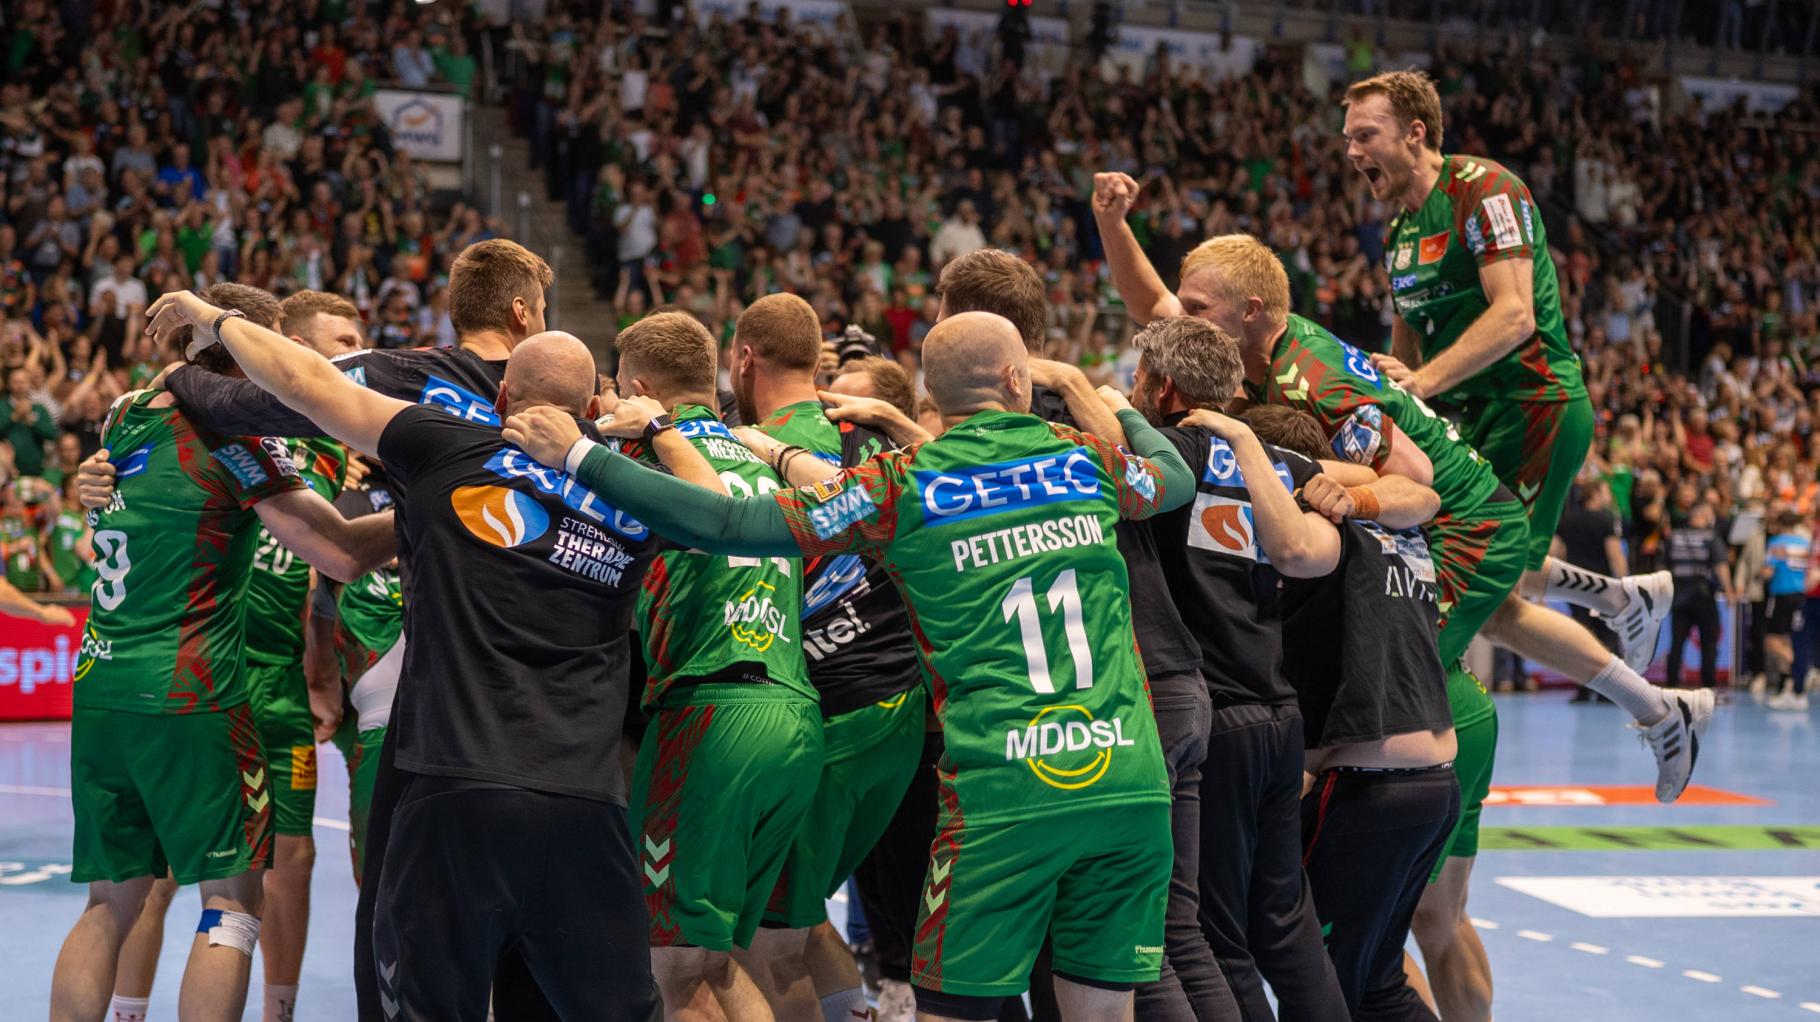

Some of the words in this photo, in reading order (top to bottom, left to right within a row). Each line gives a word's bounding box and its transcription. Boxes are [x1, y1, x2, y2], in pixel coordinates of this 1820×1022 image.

[220, 443, 265, 486] SWM
[925, 453, 1100, 517] GETEC
[812, 484, 872, 529] SWM
[549, 545, 623, 589] ZENTRUM
[557, 529, 635, 570] THERAPIE
[951, 515, 1104, 572] PETTERSSON
[803, 601, 872, 661] ntel.
[1002, 568, 1093, 693] 11
[0, 634, 79, 693] spi
[1005, 717, 1135, 761] MDDSL
